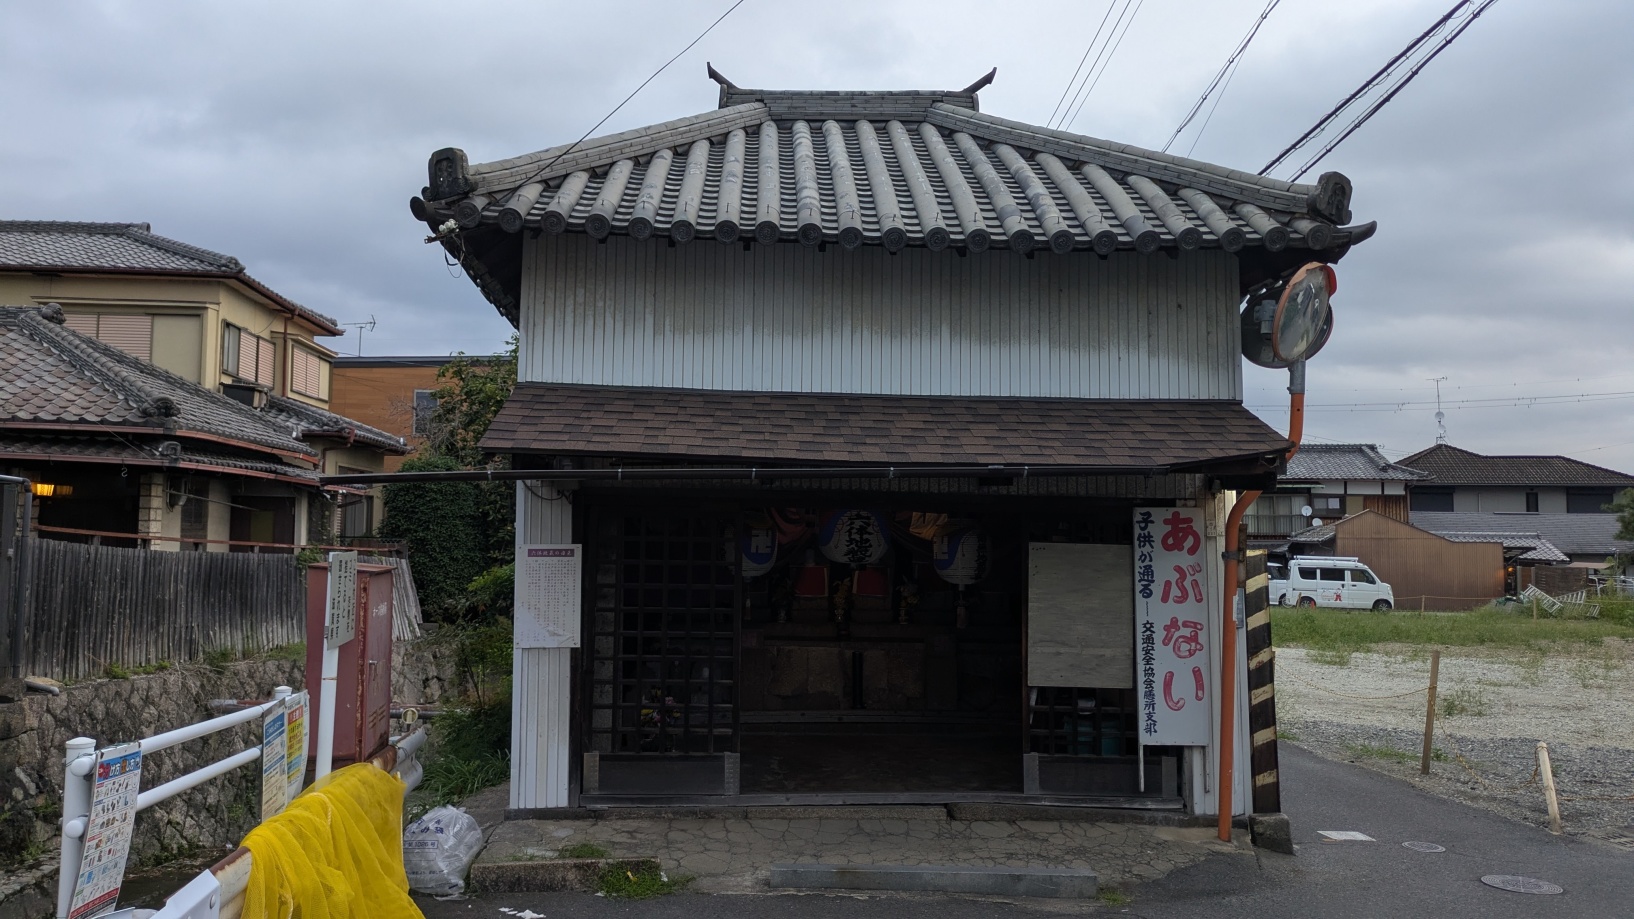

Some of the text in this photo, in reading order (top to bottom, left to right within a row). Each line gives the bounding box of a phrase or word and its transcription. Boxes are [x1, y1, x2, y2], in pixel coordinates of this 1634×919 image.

[1136, 511, 1155, 598] 子供が通る
[1160, 511, 1204, 711] あぶない
[1141, 620, 1157, 737] 交通安全協会膳所支部
